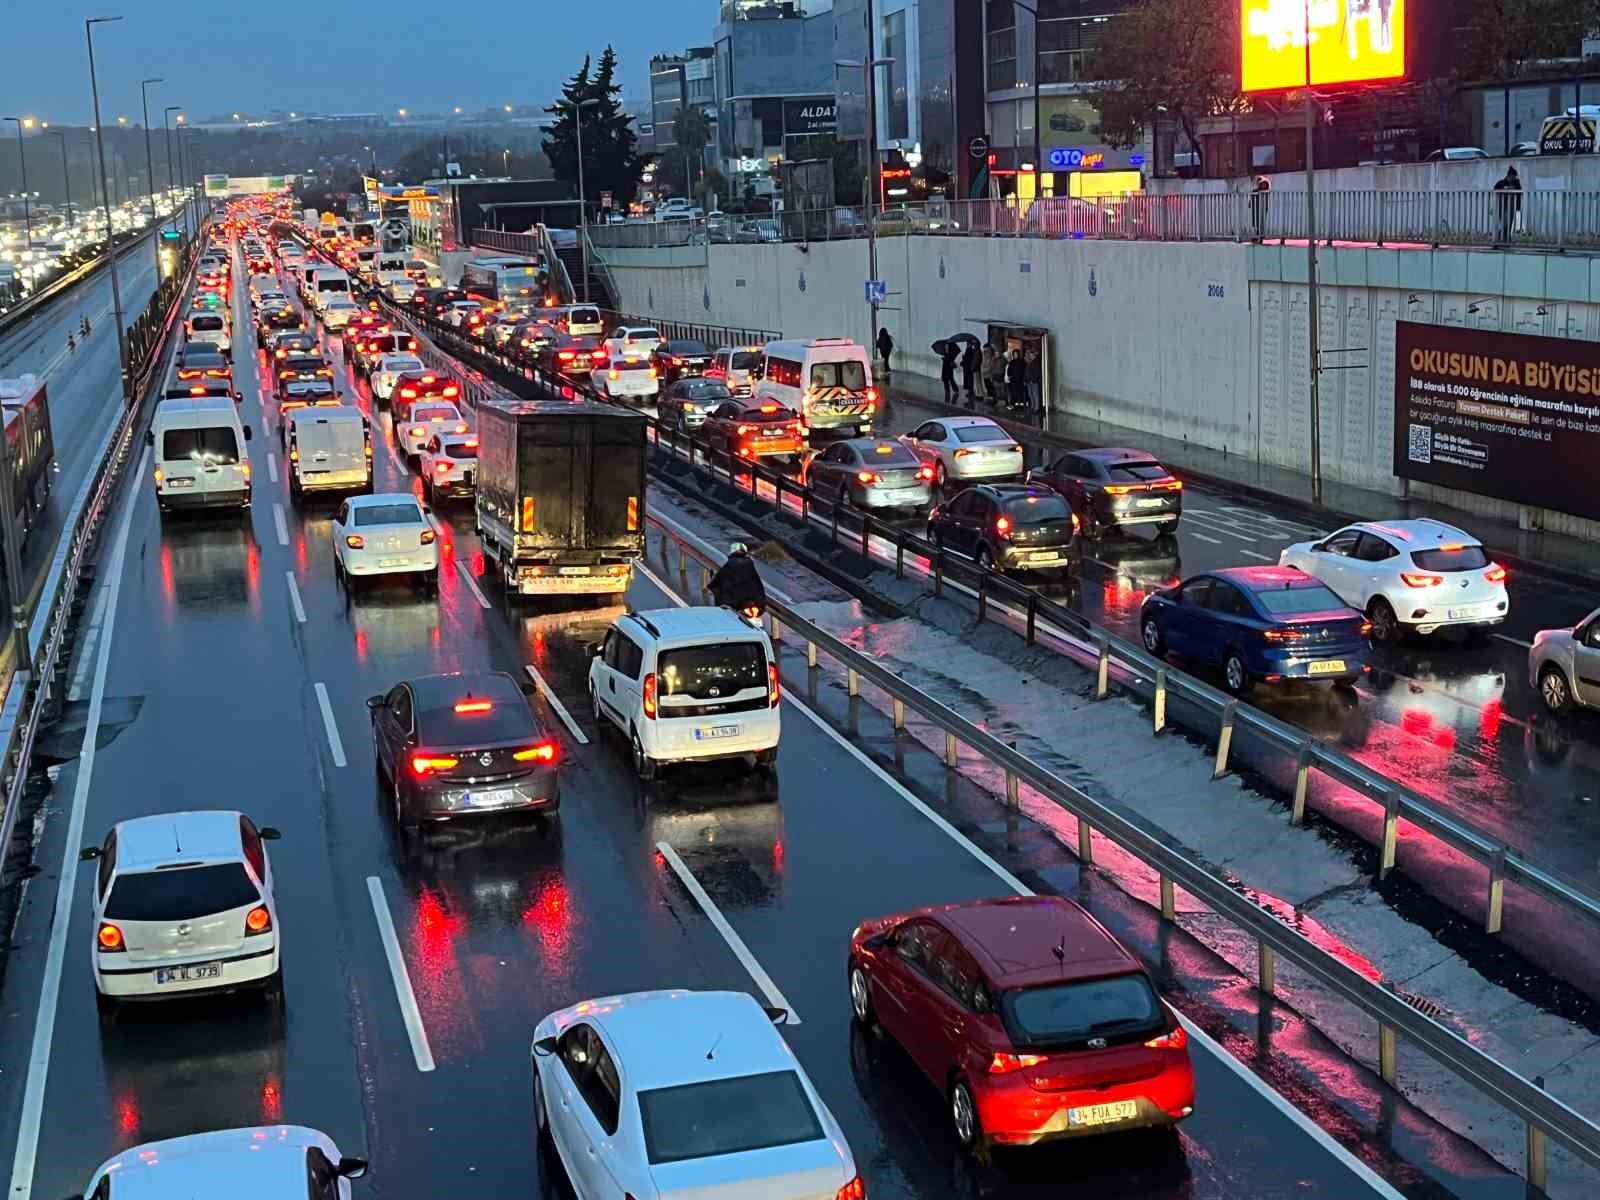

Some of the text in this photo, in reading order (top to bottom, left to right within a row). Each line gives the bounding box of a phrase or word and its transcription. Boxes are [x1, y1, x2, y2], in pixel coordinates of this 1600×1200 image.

[1050, 150, 1081, 164] OTO
[1544, 140, 1562, 150] OKUL
[1410, 349, 1600, 397] OKUSUN DA BÜYÜSÜ
[1424, 381, 1446, 393] olarak
[1447, 384, 1469, 396] 5.000
[1470, 387, 1508, 404] öğrencinin
[1509, 393, 1534, 407] eğitim
[1534, 400, 1573, 413] masrafını
[1433, 396, 1456, 409] Fatura
[1541, 416, 1555, 425] sen
[1556, 417, 1567, 427] de
[1568, 420, 1584, 431] bize
[1077, 1102, 1133, 1121] 34 FUA 577
